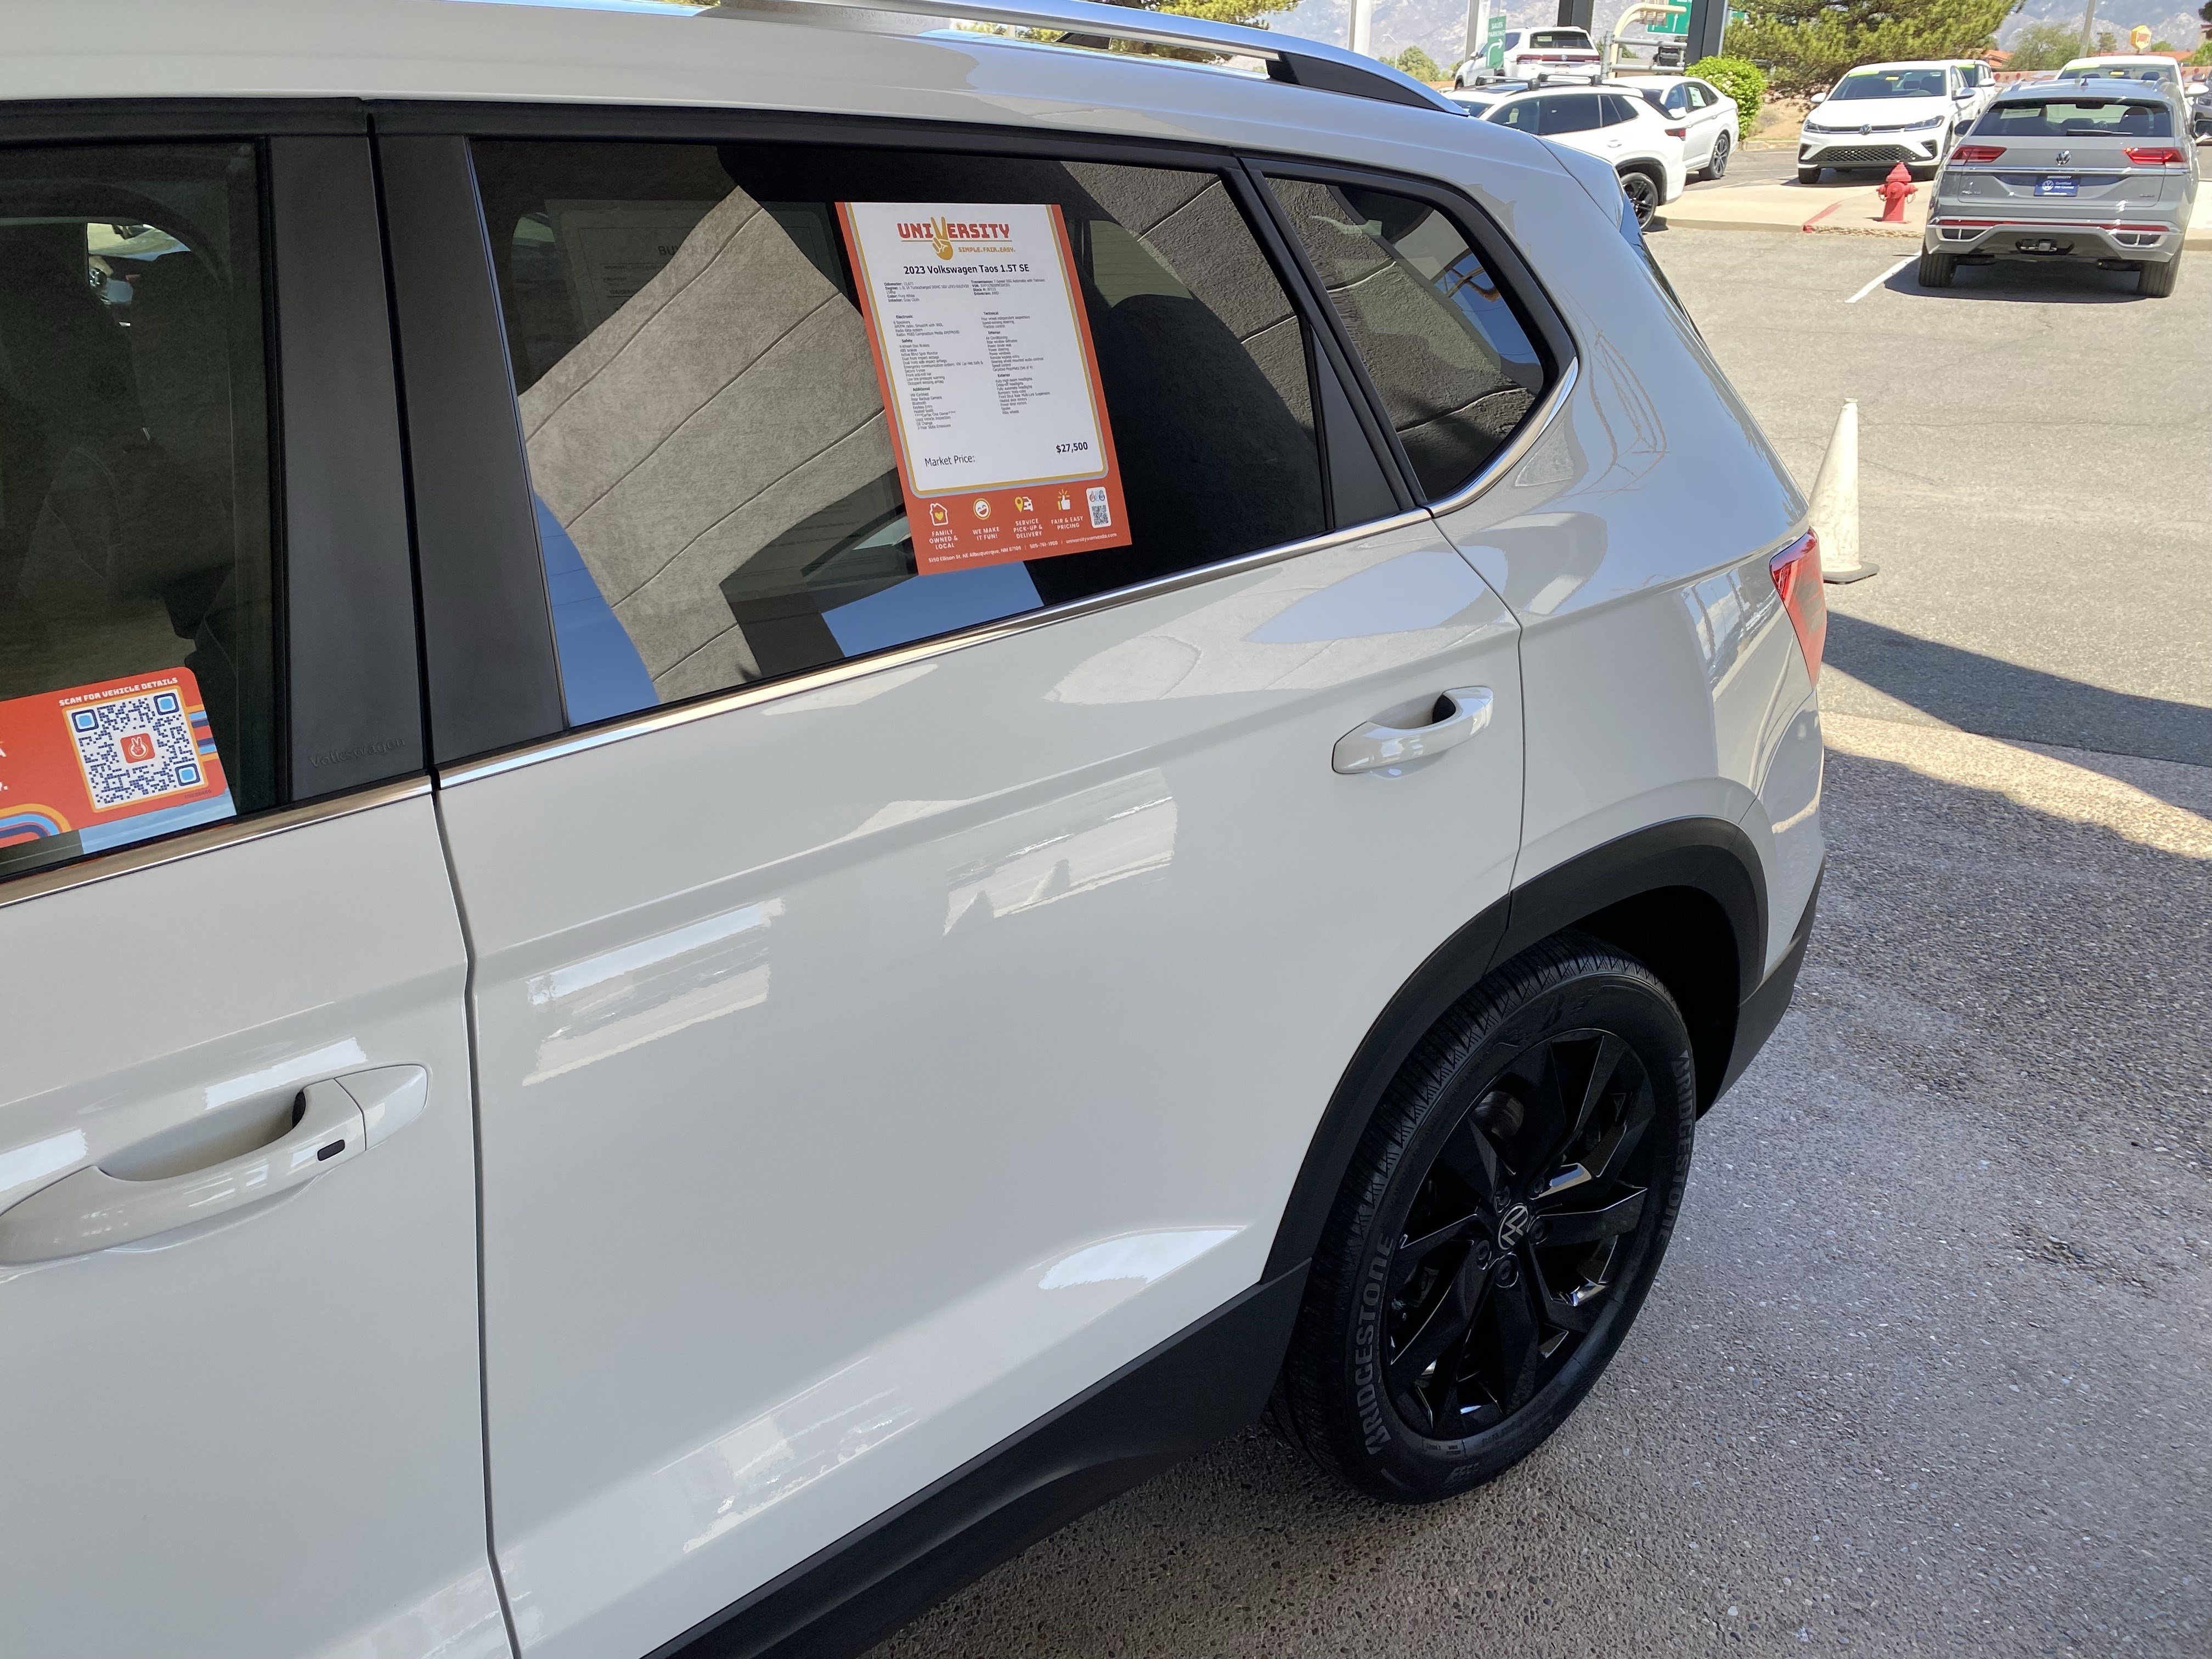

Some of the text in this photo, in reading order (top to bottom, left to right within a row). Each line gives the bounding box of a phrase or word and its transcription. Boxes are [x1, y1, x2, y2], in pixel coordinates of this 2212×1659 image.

[896, 219, 1012, 238] UNIVERSITY
[903, 266, 926, 274] 2023
[927, 264, 978, 275] Volkswagen
[978, 264, 998, 273] Taos
[1000, 264, 1018, 272] 1.5T
[1055, 441, 1088, 454] $27,500
[924, 454, 975, 467] Market Price:
[1015, 518, 1039, 526] SERVICE
[1015, 531, 1042, 539] DELIVERY
[59, 677, 178, 707] SCAN FOR VEHICLE DETAILS
[1355, 1233, 1393, 1455] BRIDGESTONE
